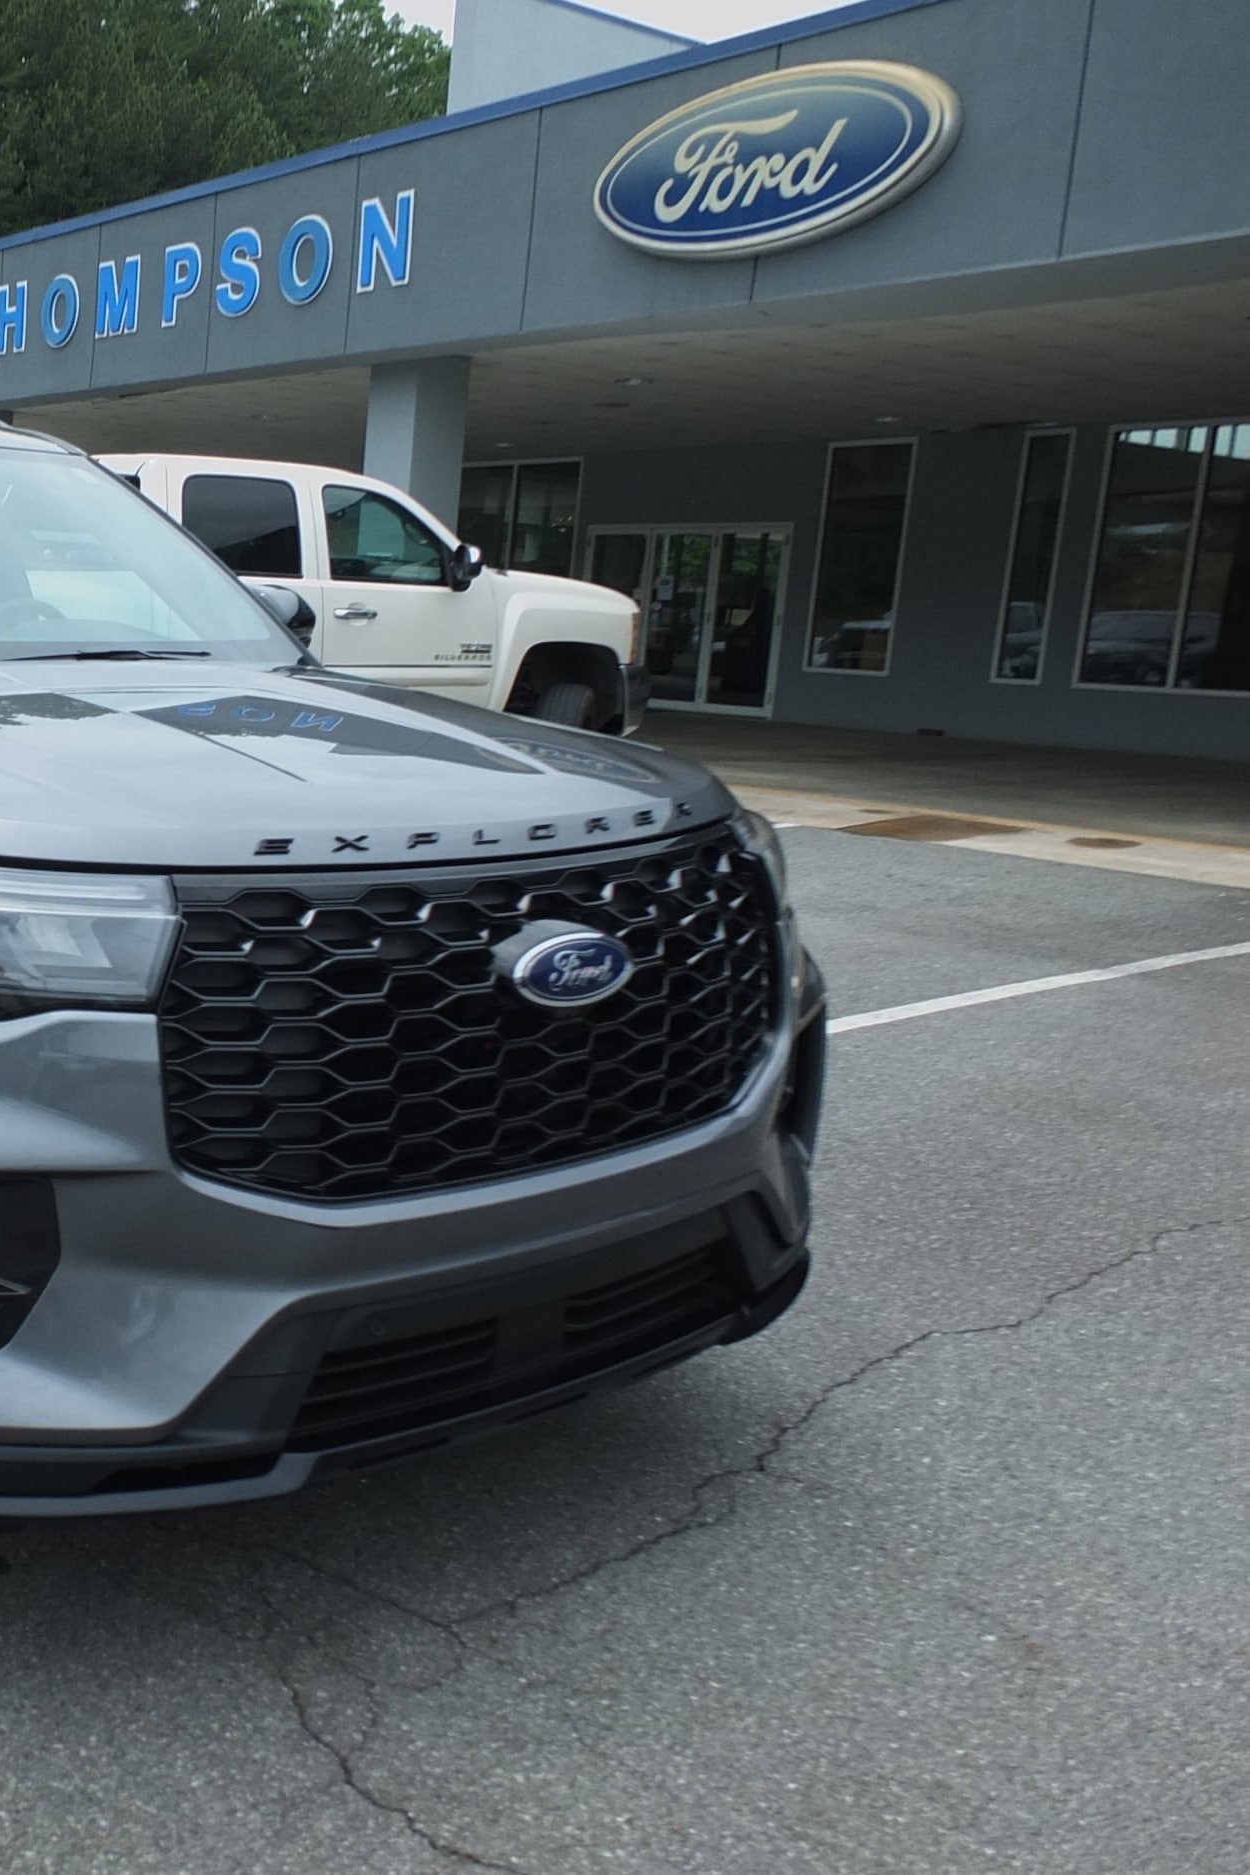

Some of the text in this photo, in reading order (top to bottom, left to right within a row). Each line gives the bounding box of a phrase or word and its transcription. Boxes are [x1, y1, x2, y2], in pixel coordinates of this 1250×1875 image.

[654, 108, 849, 224] Ford
[253, 801, 694, 856] EXPLORER
[549, 946, 614, 988] Ford
